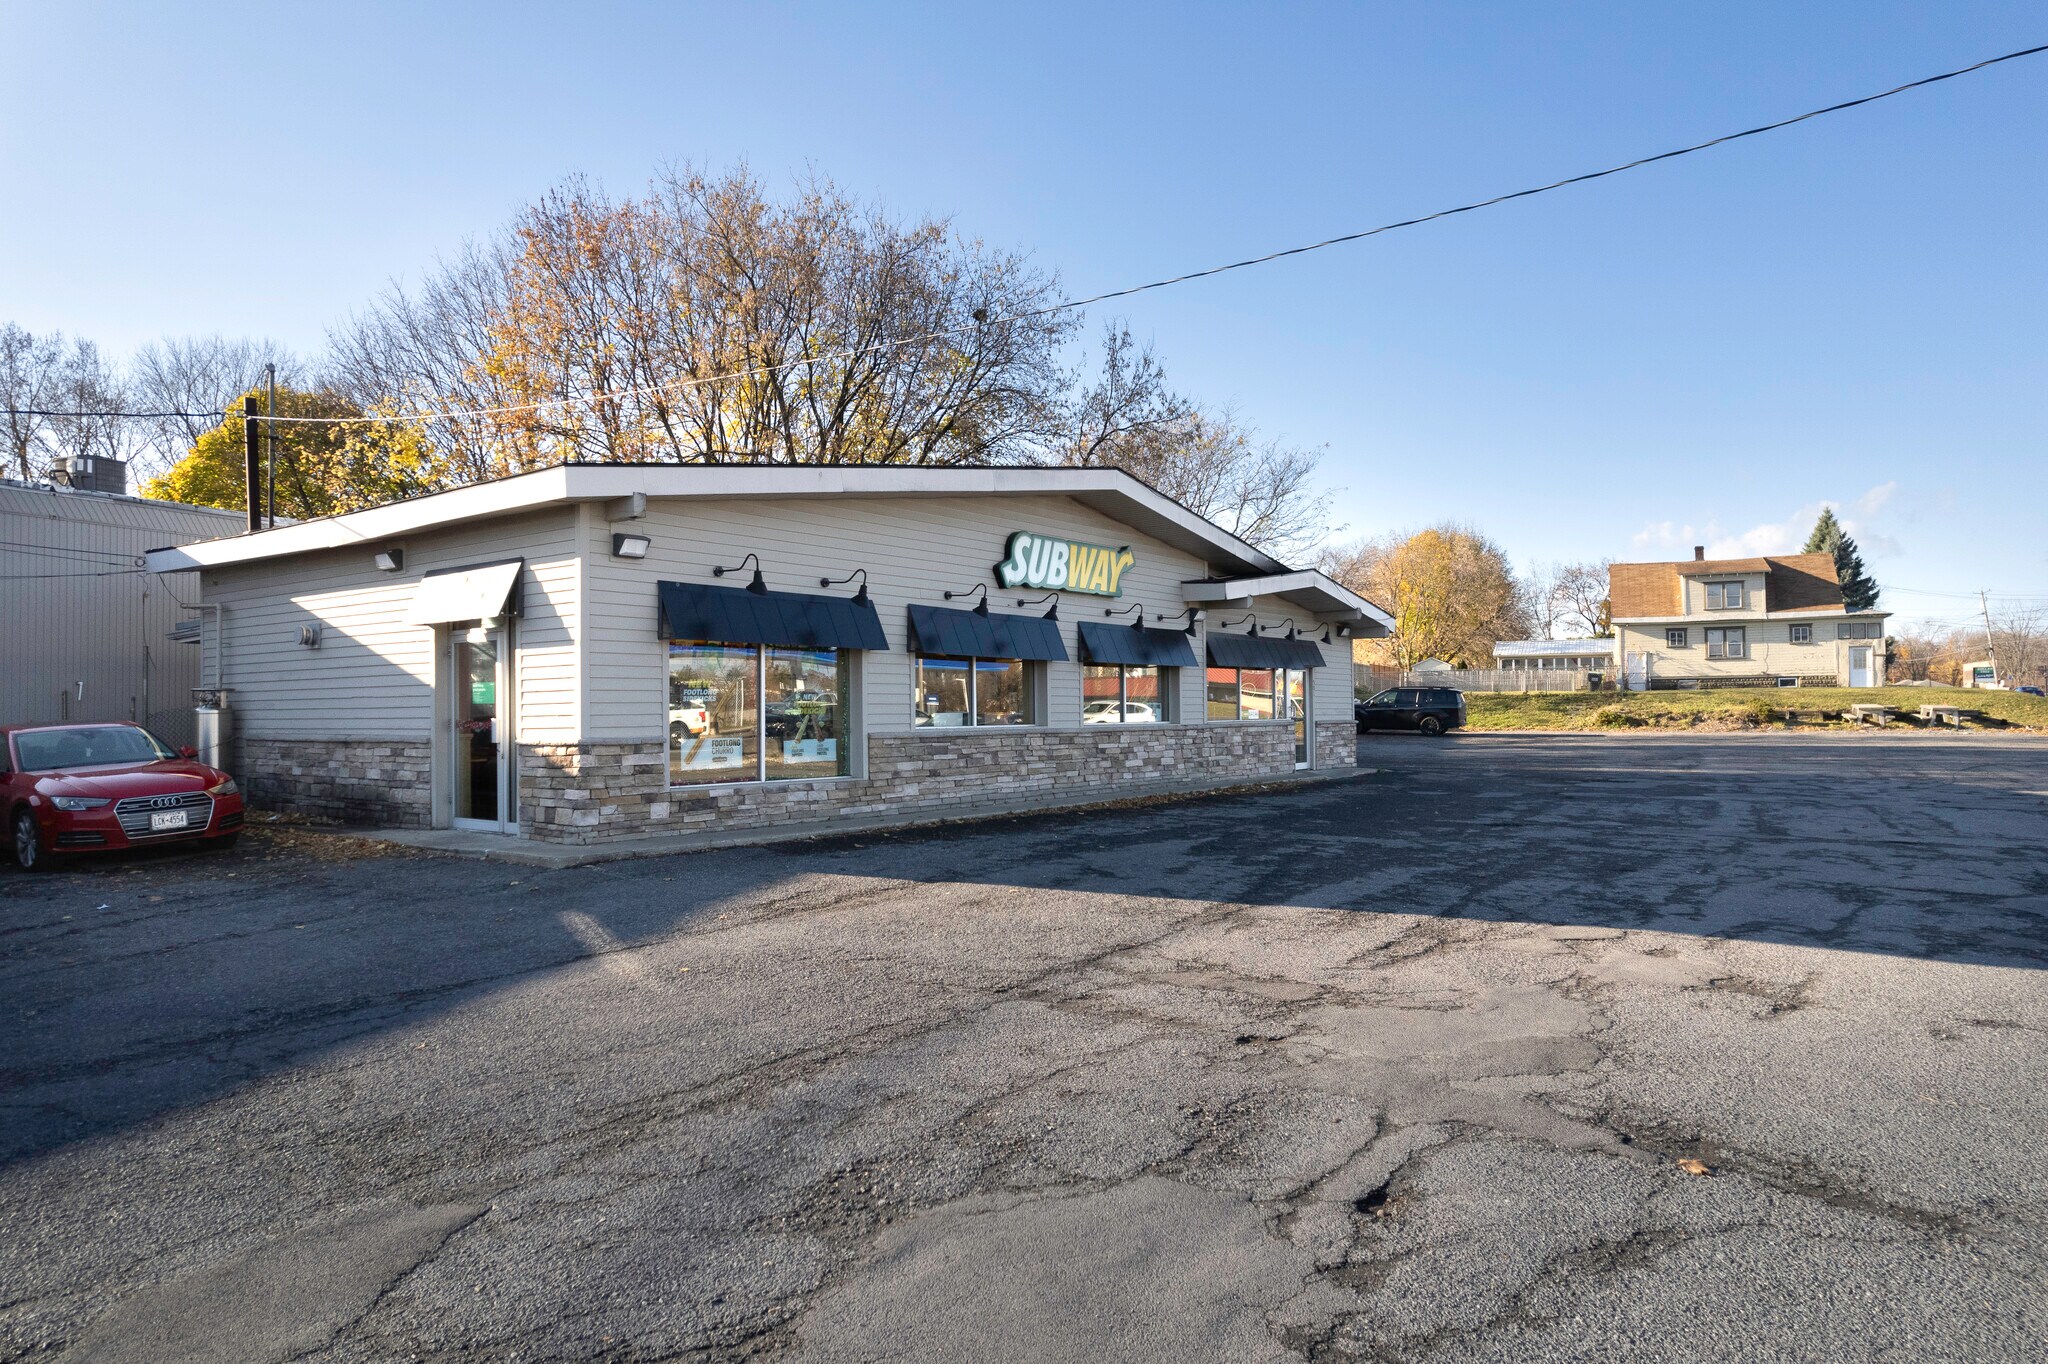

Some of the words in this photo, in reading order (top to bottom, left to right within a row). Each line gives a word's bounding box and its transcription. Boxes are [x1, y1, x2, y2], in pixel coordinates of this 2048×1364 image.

[1003, 535, 1134, 593] SUBWAY
[712, 739, 741, 747] FOOTLONG
[712, 747, 734, 755] CHURRO
